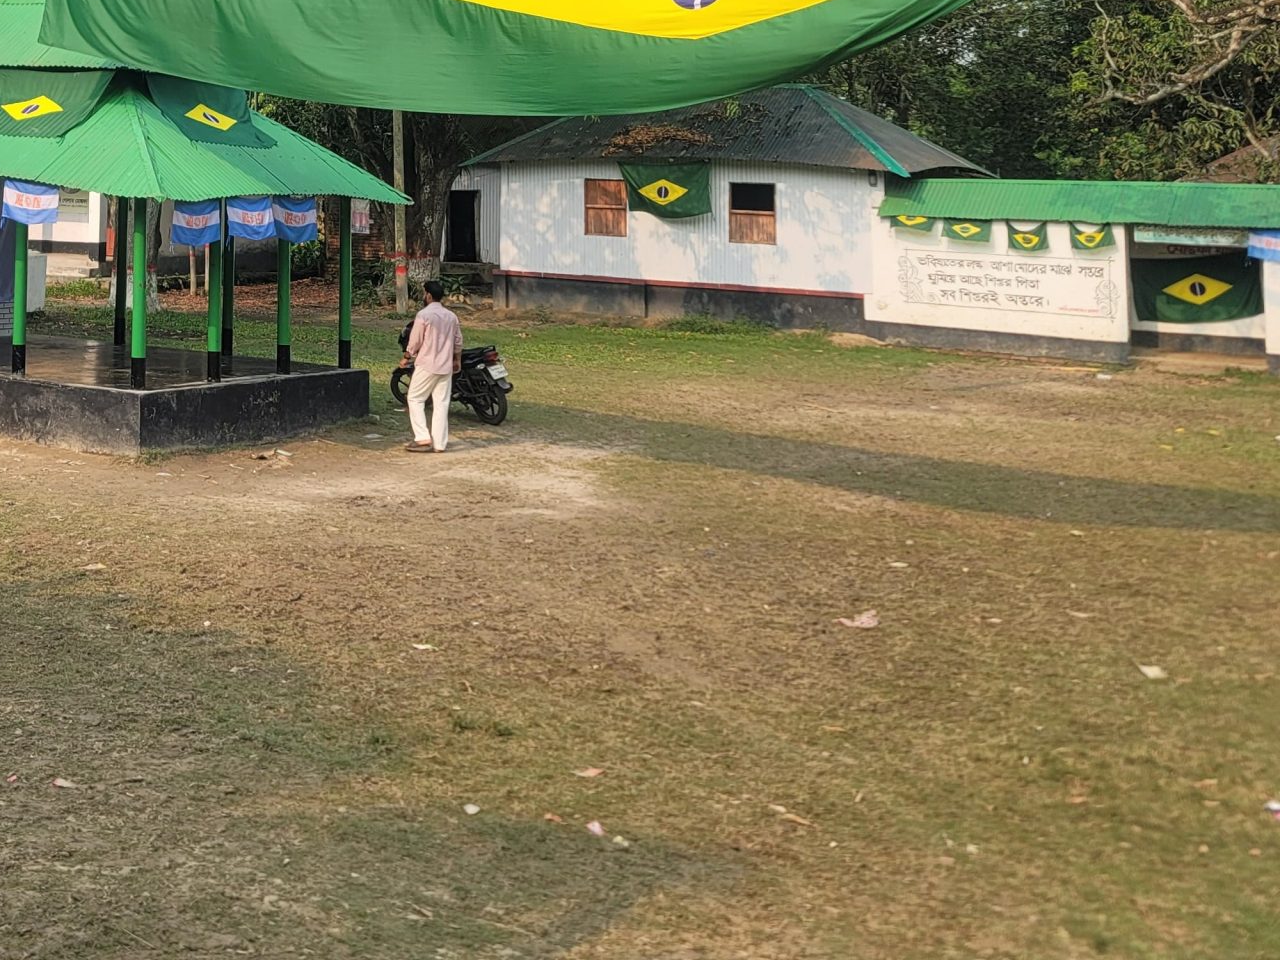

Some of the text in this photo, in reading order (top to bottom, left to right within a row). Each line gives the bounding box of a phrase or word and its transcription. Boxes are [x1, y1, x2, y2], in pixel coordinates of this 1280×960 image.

[959, 274, 984, 287] আছে
[1014, 276, 1041, 290] পিতা
[939, 288, 957, 302] সব
